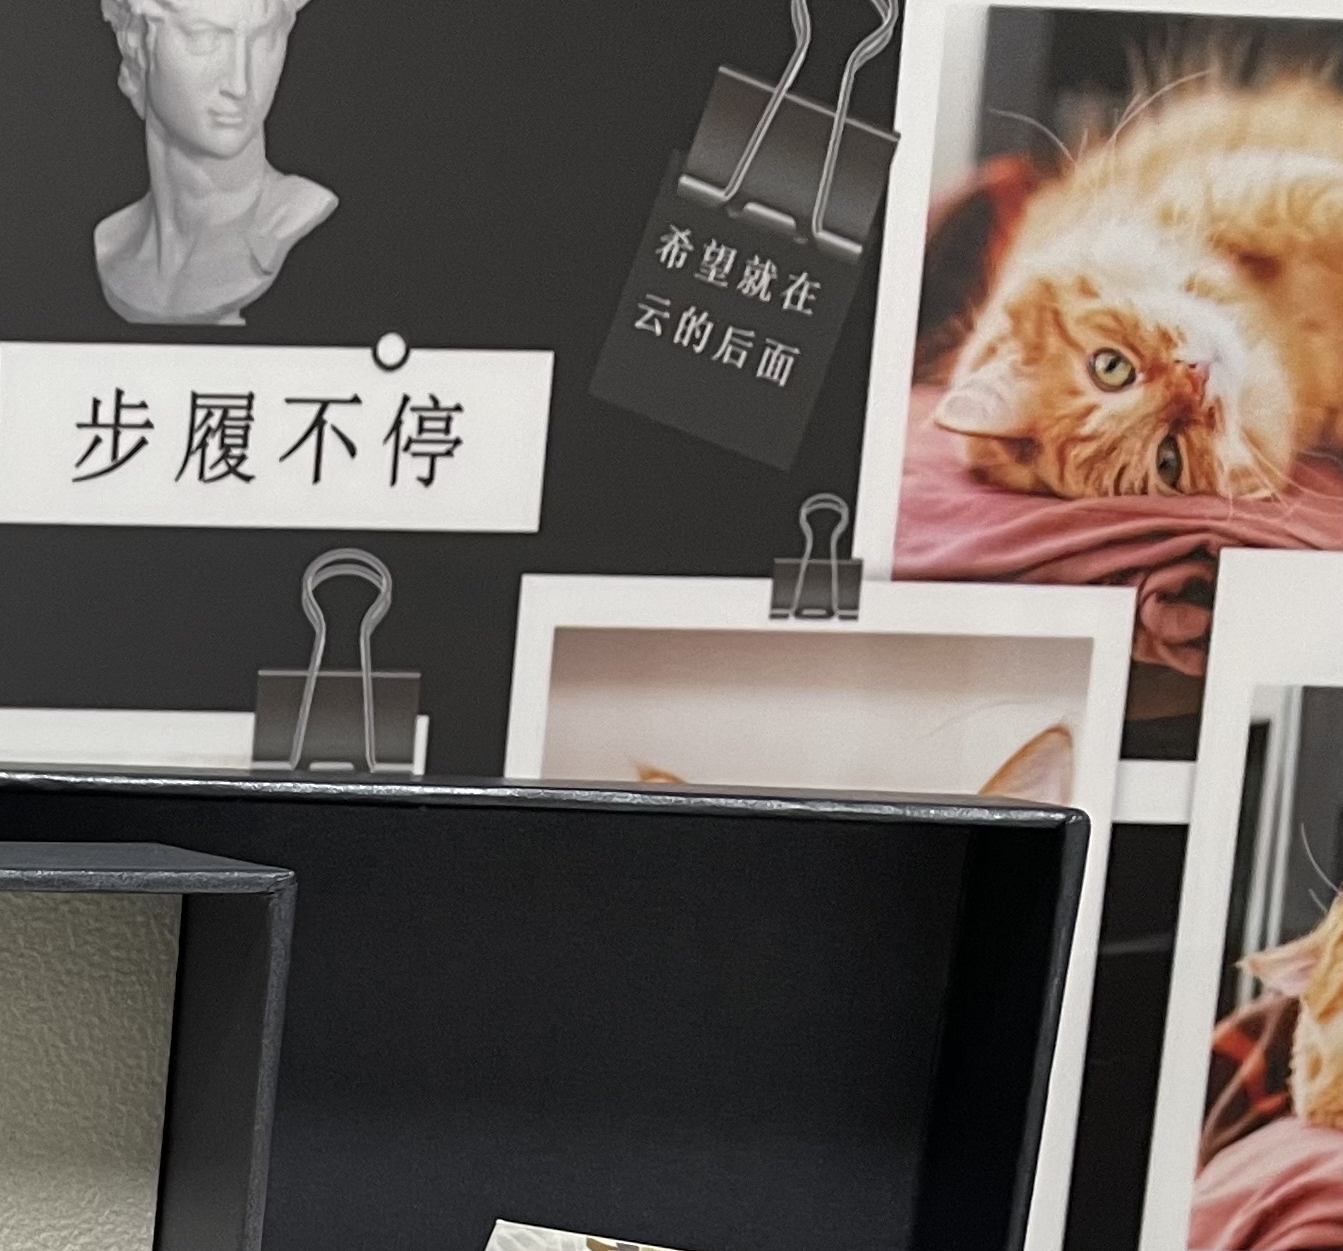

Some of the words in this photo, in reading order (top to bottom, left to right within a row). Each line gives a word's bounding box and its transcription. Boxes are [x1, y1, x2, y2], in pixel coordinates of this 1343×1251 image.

[655, 224, 822, 315] 希望就在
[634, 293, 801, 387] 云的后面
[71, 387, 464, 489] 步履不停
